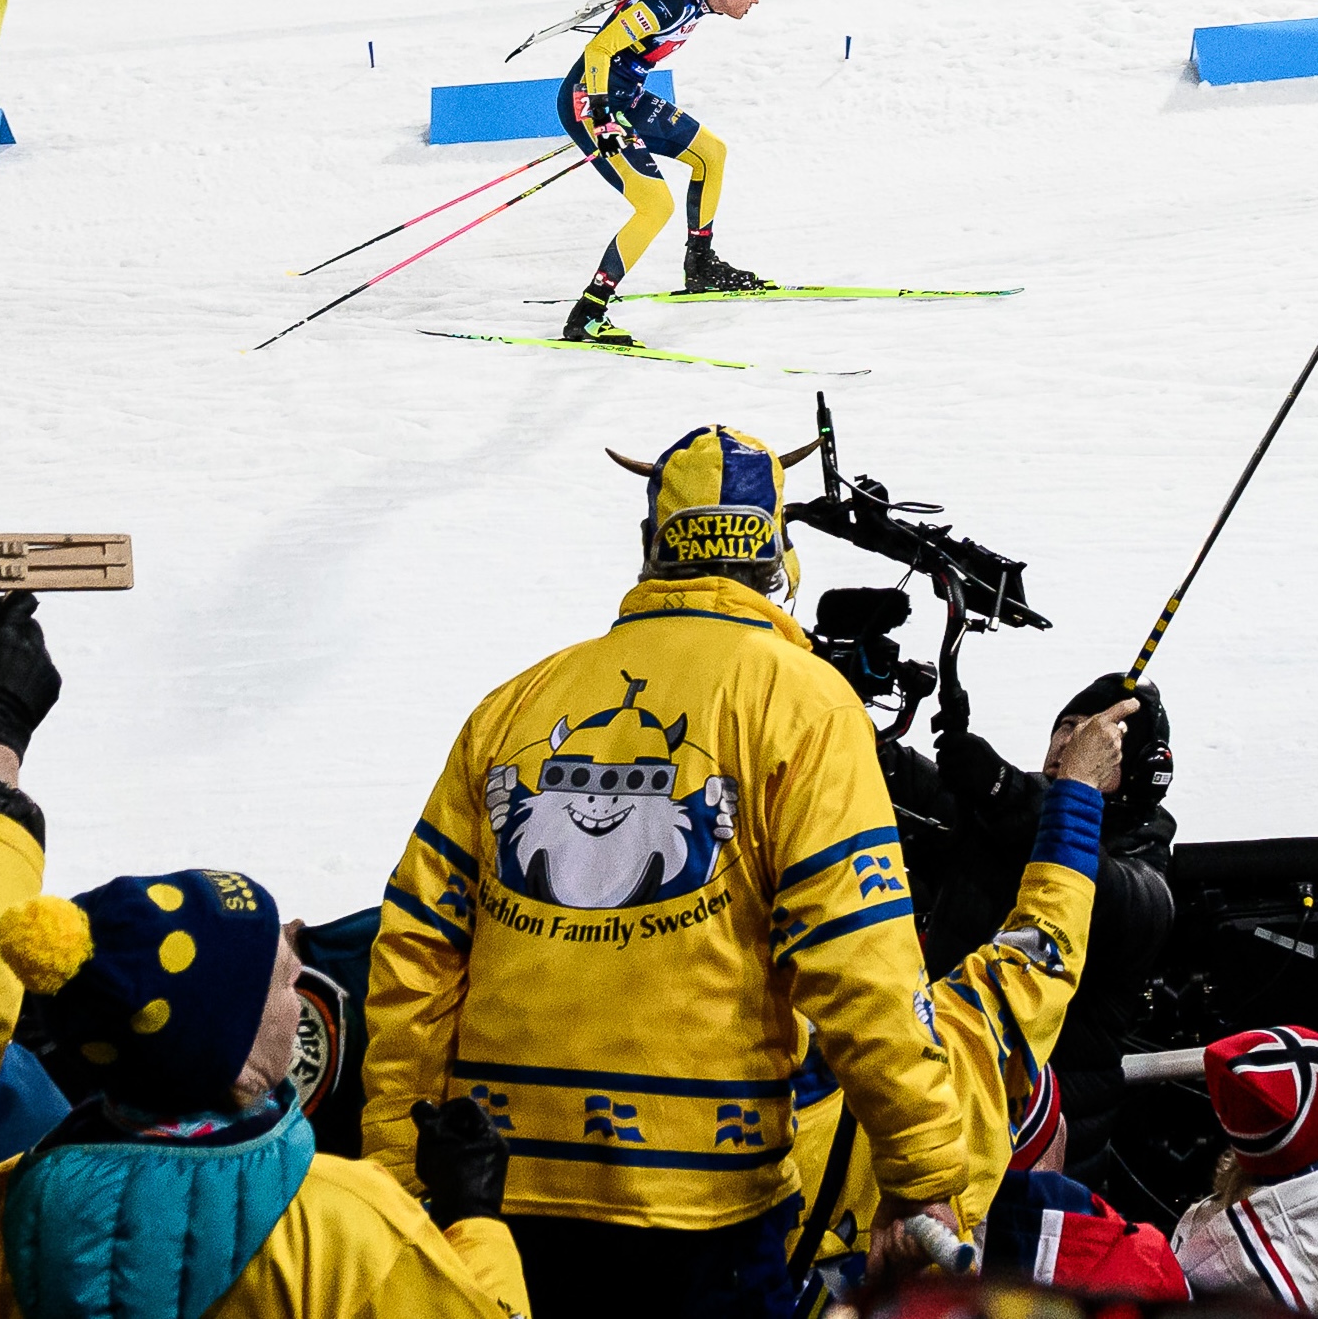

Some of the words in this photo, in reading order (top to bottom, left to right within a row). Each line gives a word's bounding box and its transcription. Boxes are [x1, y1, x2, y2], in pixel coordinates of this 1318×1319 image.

[634, 10, 652, 32] NIBE
[580, 96, 591, 118] 2
[664, 514, 776, 549] BIATHLON
[676, 537, 765, 562] FAMILY
[479, 879, 544, 937] iathlon
[549, 915, 635, 951] Family
[640, 888, 733, 940] Sweden
